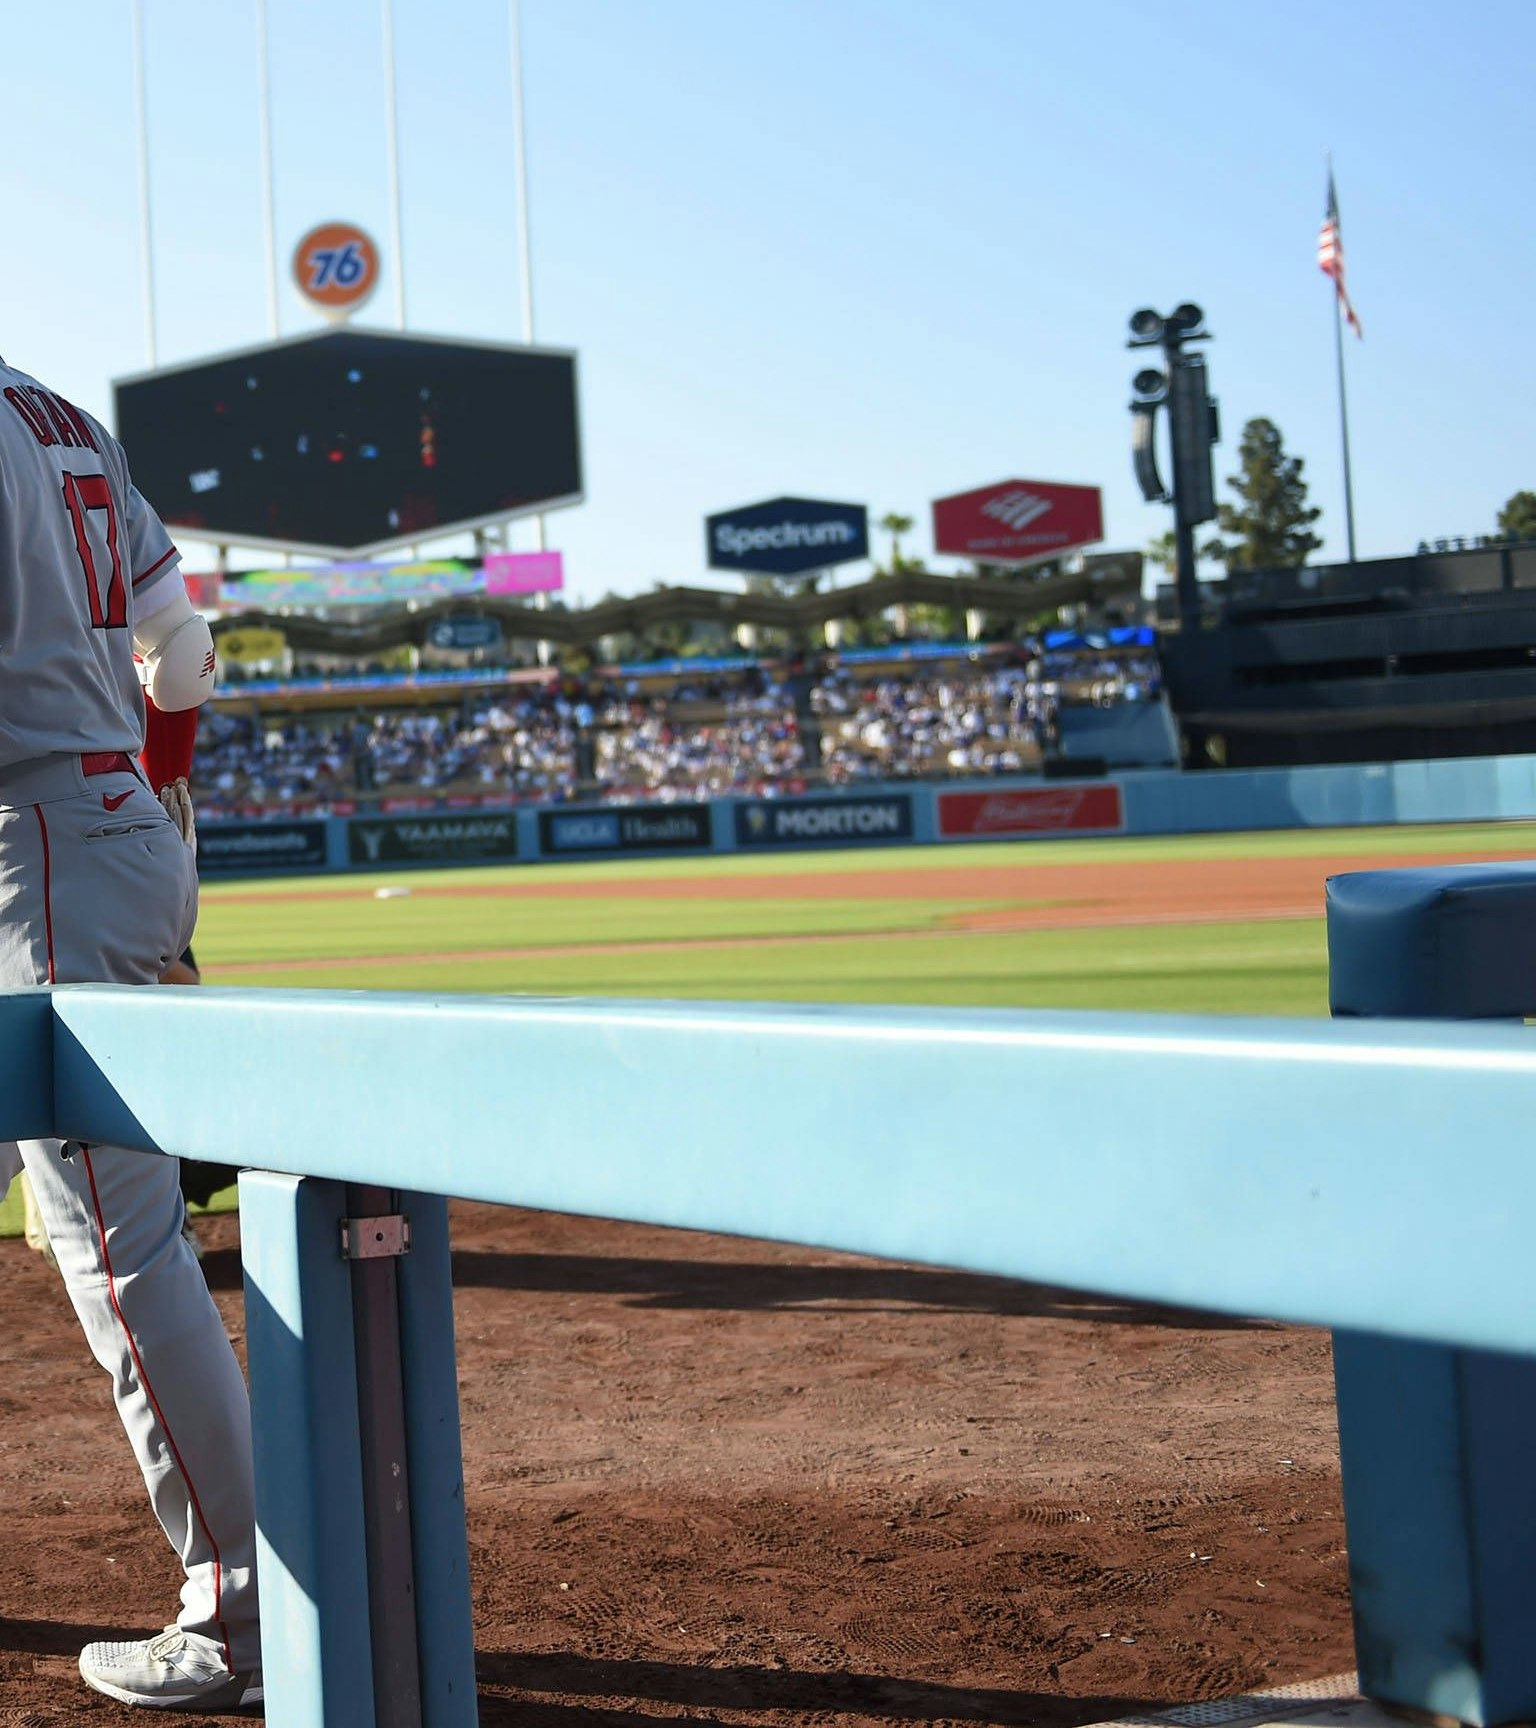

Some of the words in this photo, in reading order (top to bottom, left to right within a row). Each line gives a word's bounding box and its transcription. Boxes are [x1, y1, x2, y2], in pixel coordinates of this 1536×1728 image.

[307, 241, 368, 290] 76
[62, 470, 129, 629] 17
[716, 521, 850, 556] Spectrum
[623, 814, 698, 841] Health
[776, 806, 899, 836] MORTON
